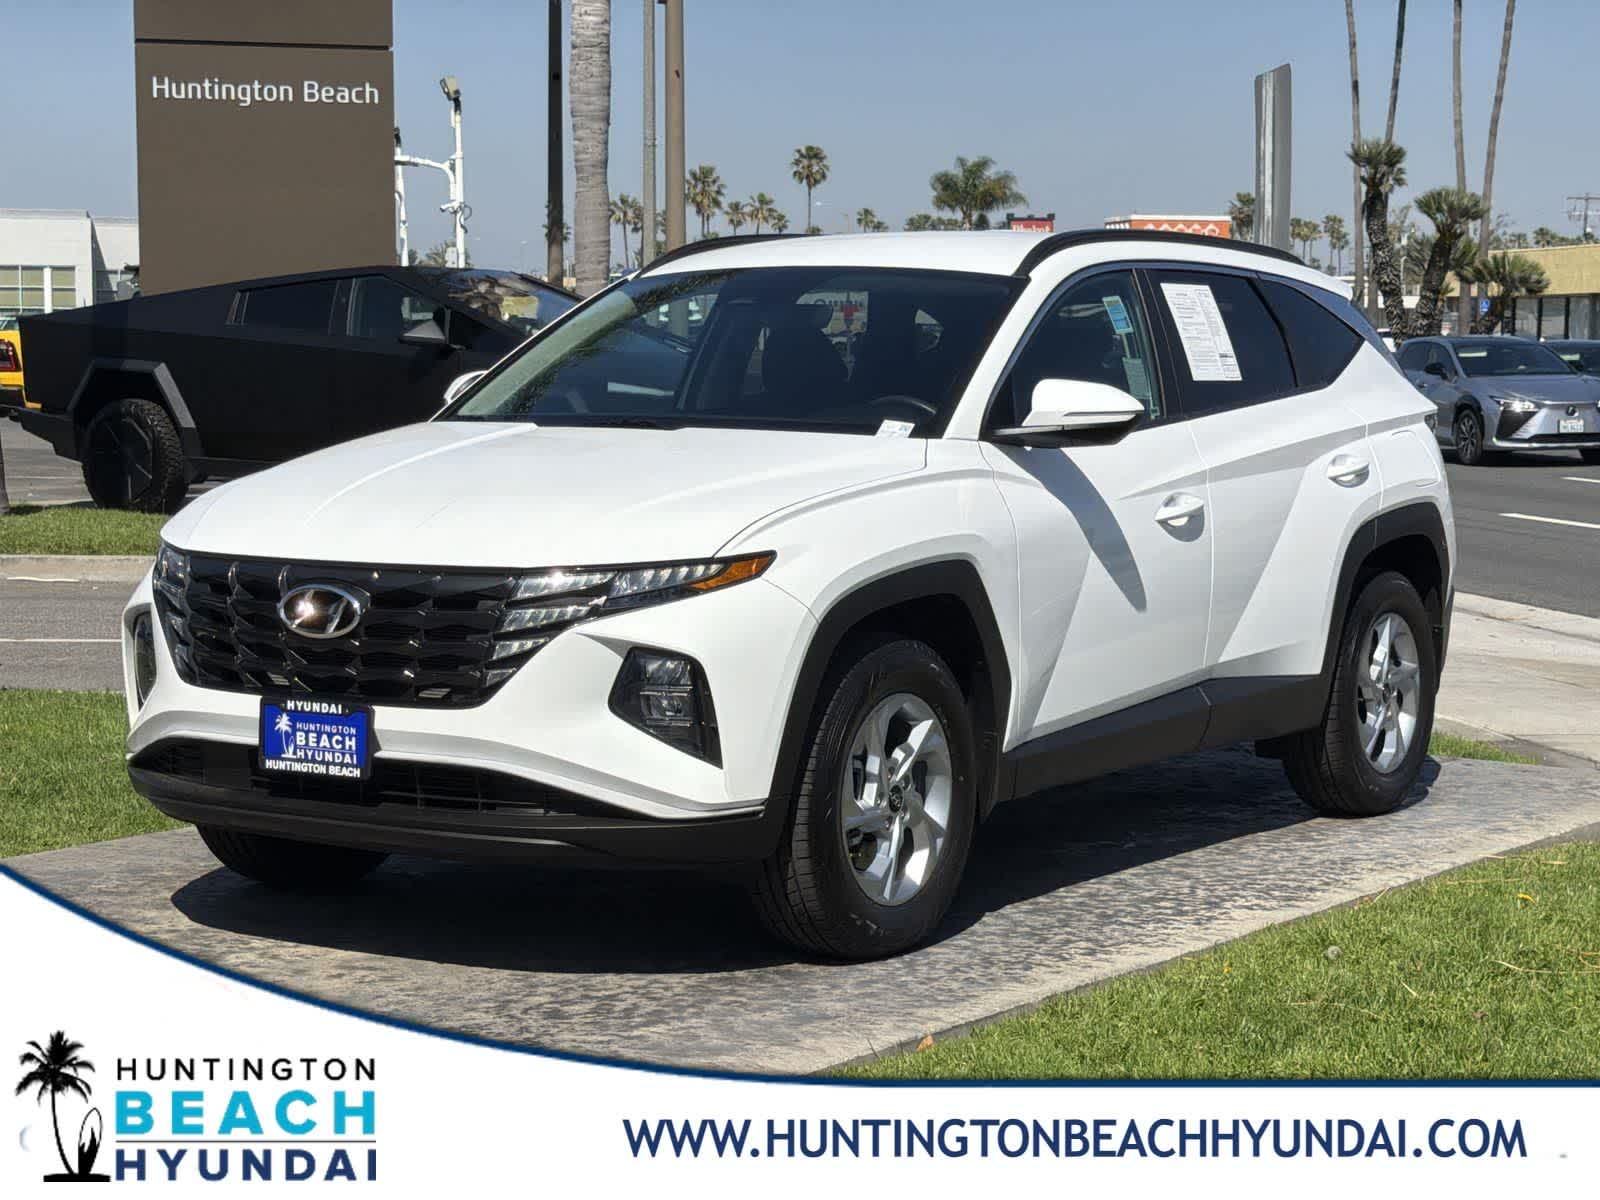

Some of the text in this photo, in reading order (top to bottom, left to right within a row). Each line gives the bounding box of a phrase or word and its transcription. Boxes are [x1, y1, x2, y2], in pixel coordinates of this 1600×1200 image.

[152, 76, 379, 106] Huntington Beach
[287, 700, 342, 715] HYUNDAI
[296, 722, 356, 735] HUNTINGTON
[296, 731, 356, 751] BEACH
[296, 749, 357, 764] HYUNDAI
[265, 759, 360, 778] HUNTINGTON BEACH
